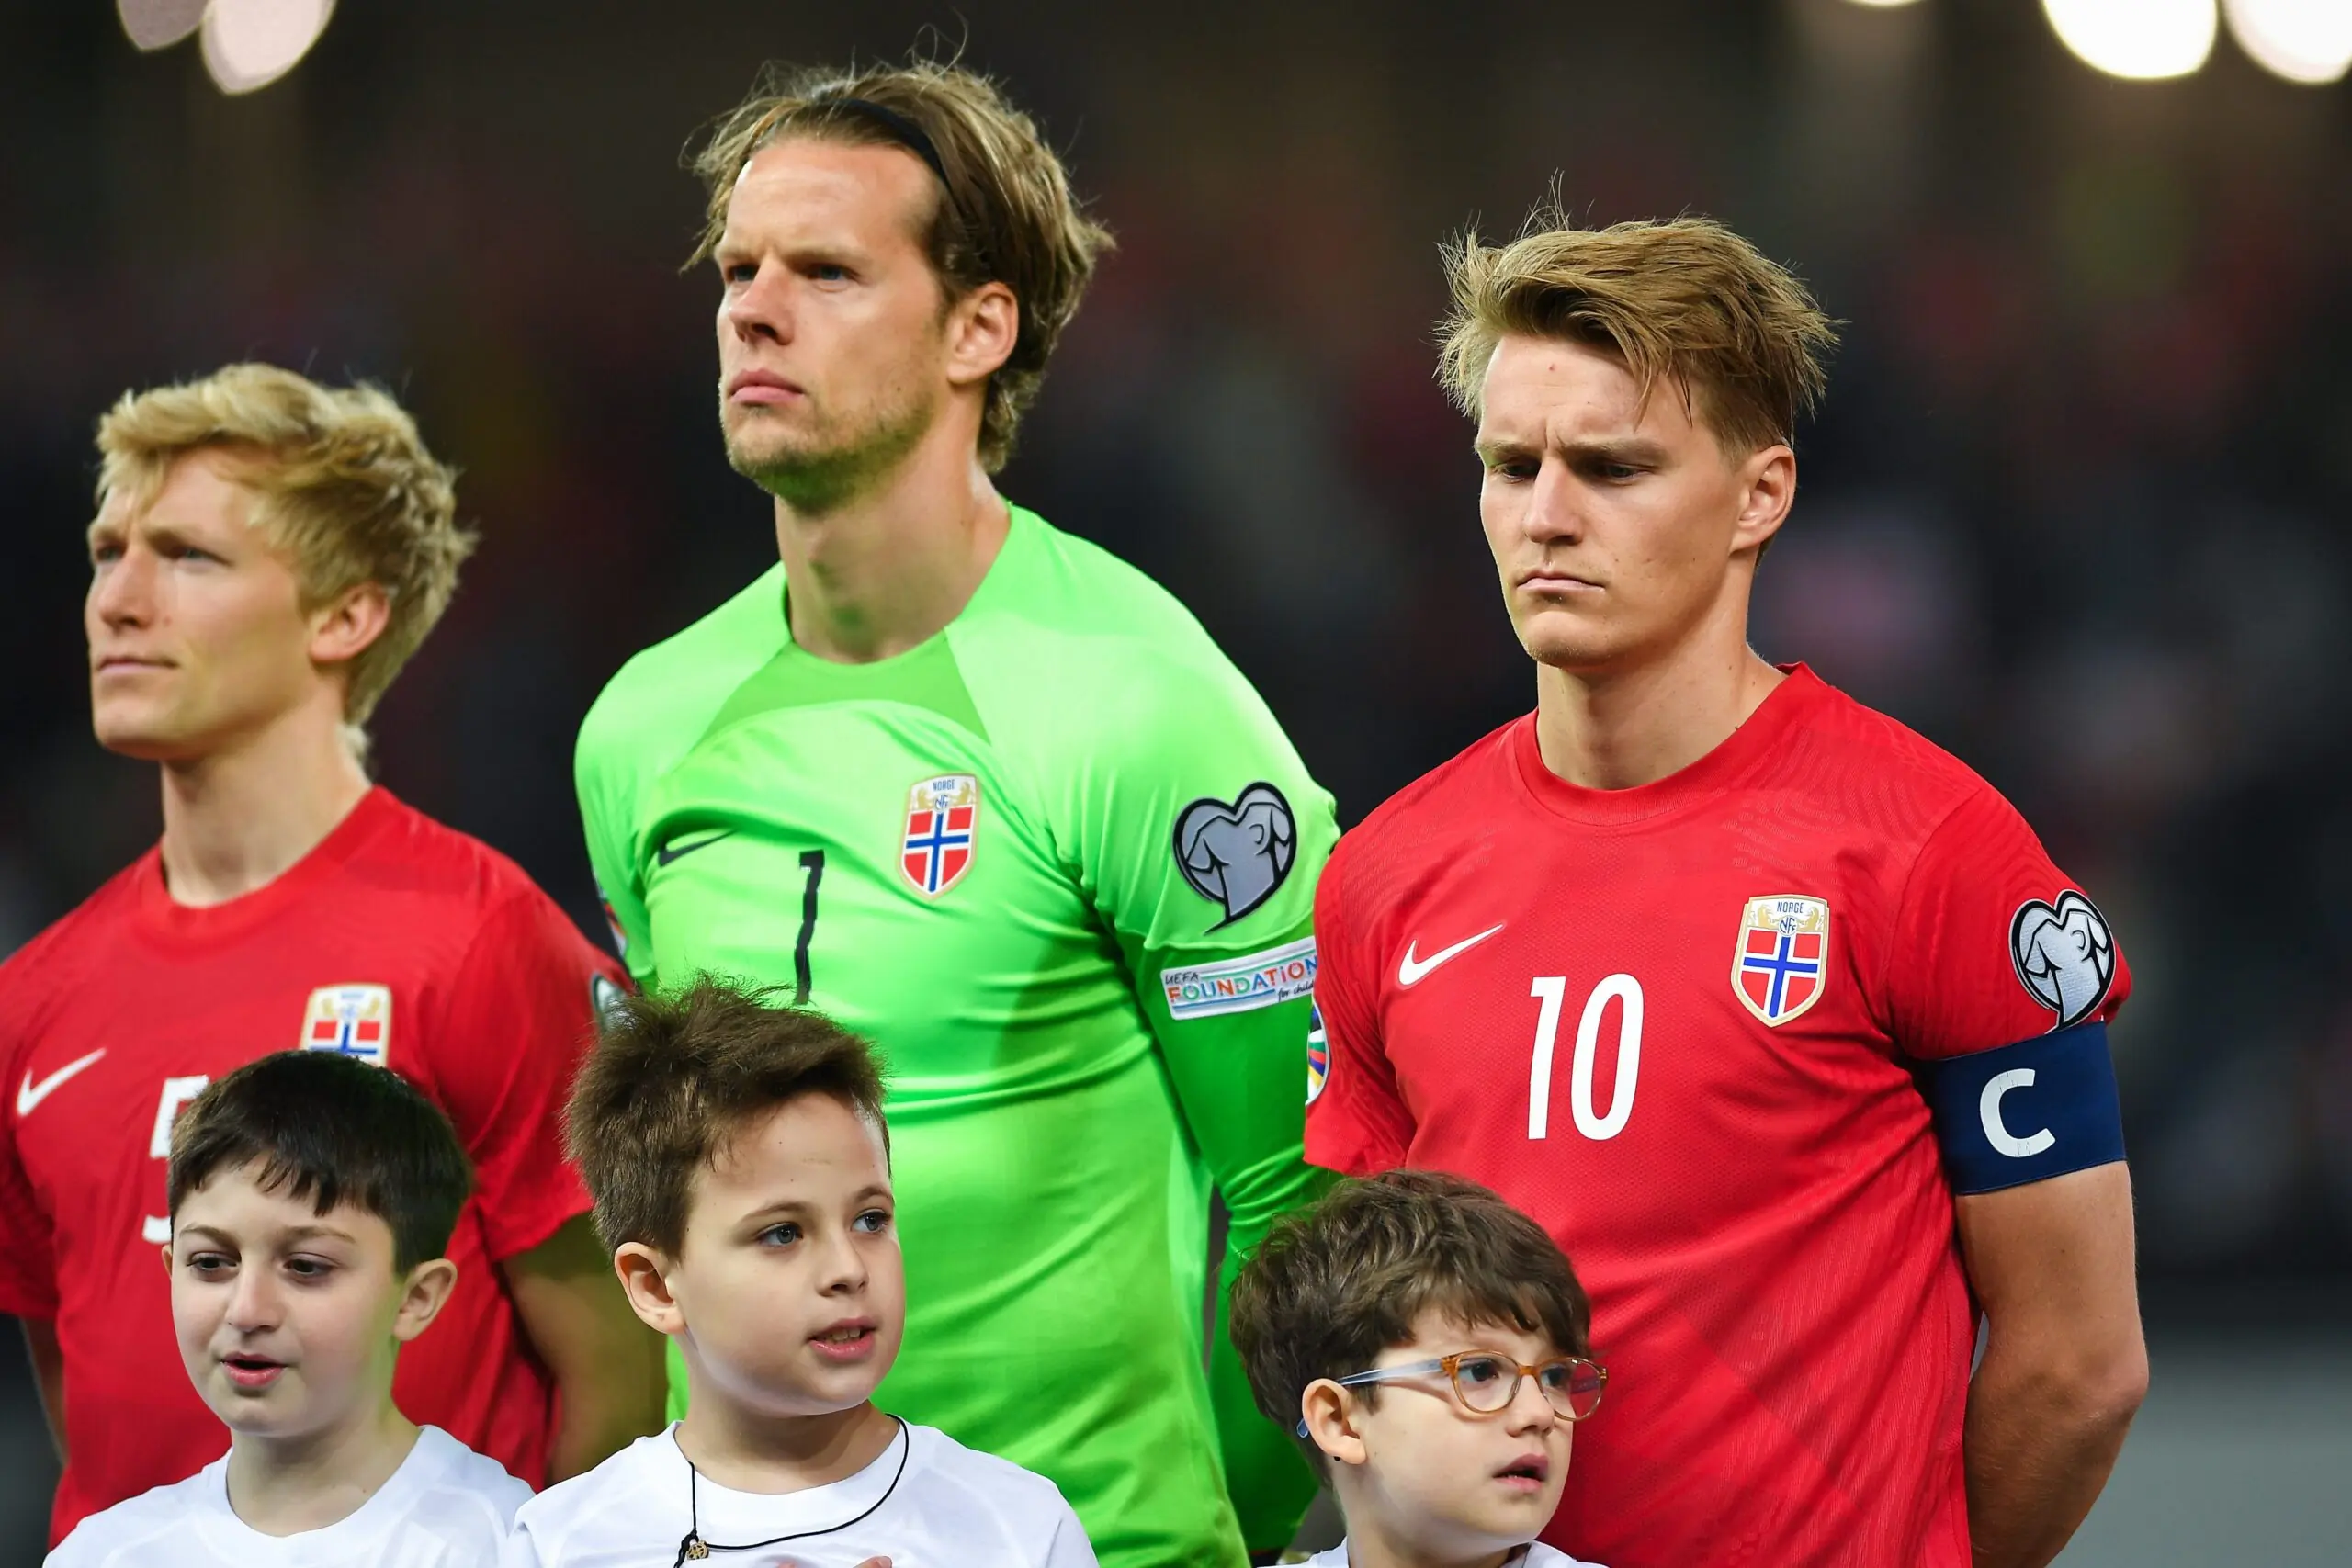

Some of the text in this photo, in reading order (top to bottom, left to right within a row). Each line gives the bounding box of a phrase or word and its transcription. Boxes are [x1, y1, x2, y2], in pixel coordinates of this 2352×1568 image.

[933, 779, 956, 791] NORGE
[1777, 901, 1804, 914] NORGE
[794, 849, 825, 1005] 1
[1165, 970, 1200, 985] UEFA
[1278, 987, 1291, 1002] for
[1528, 973, 1645, 1141] 10
[1980, 1068, 2056, 1158] C
